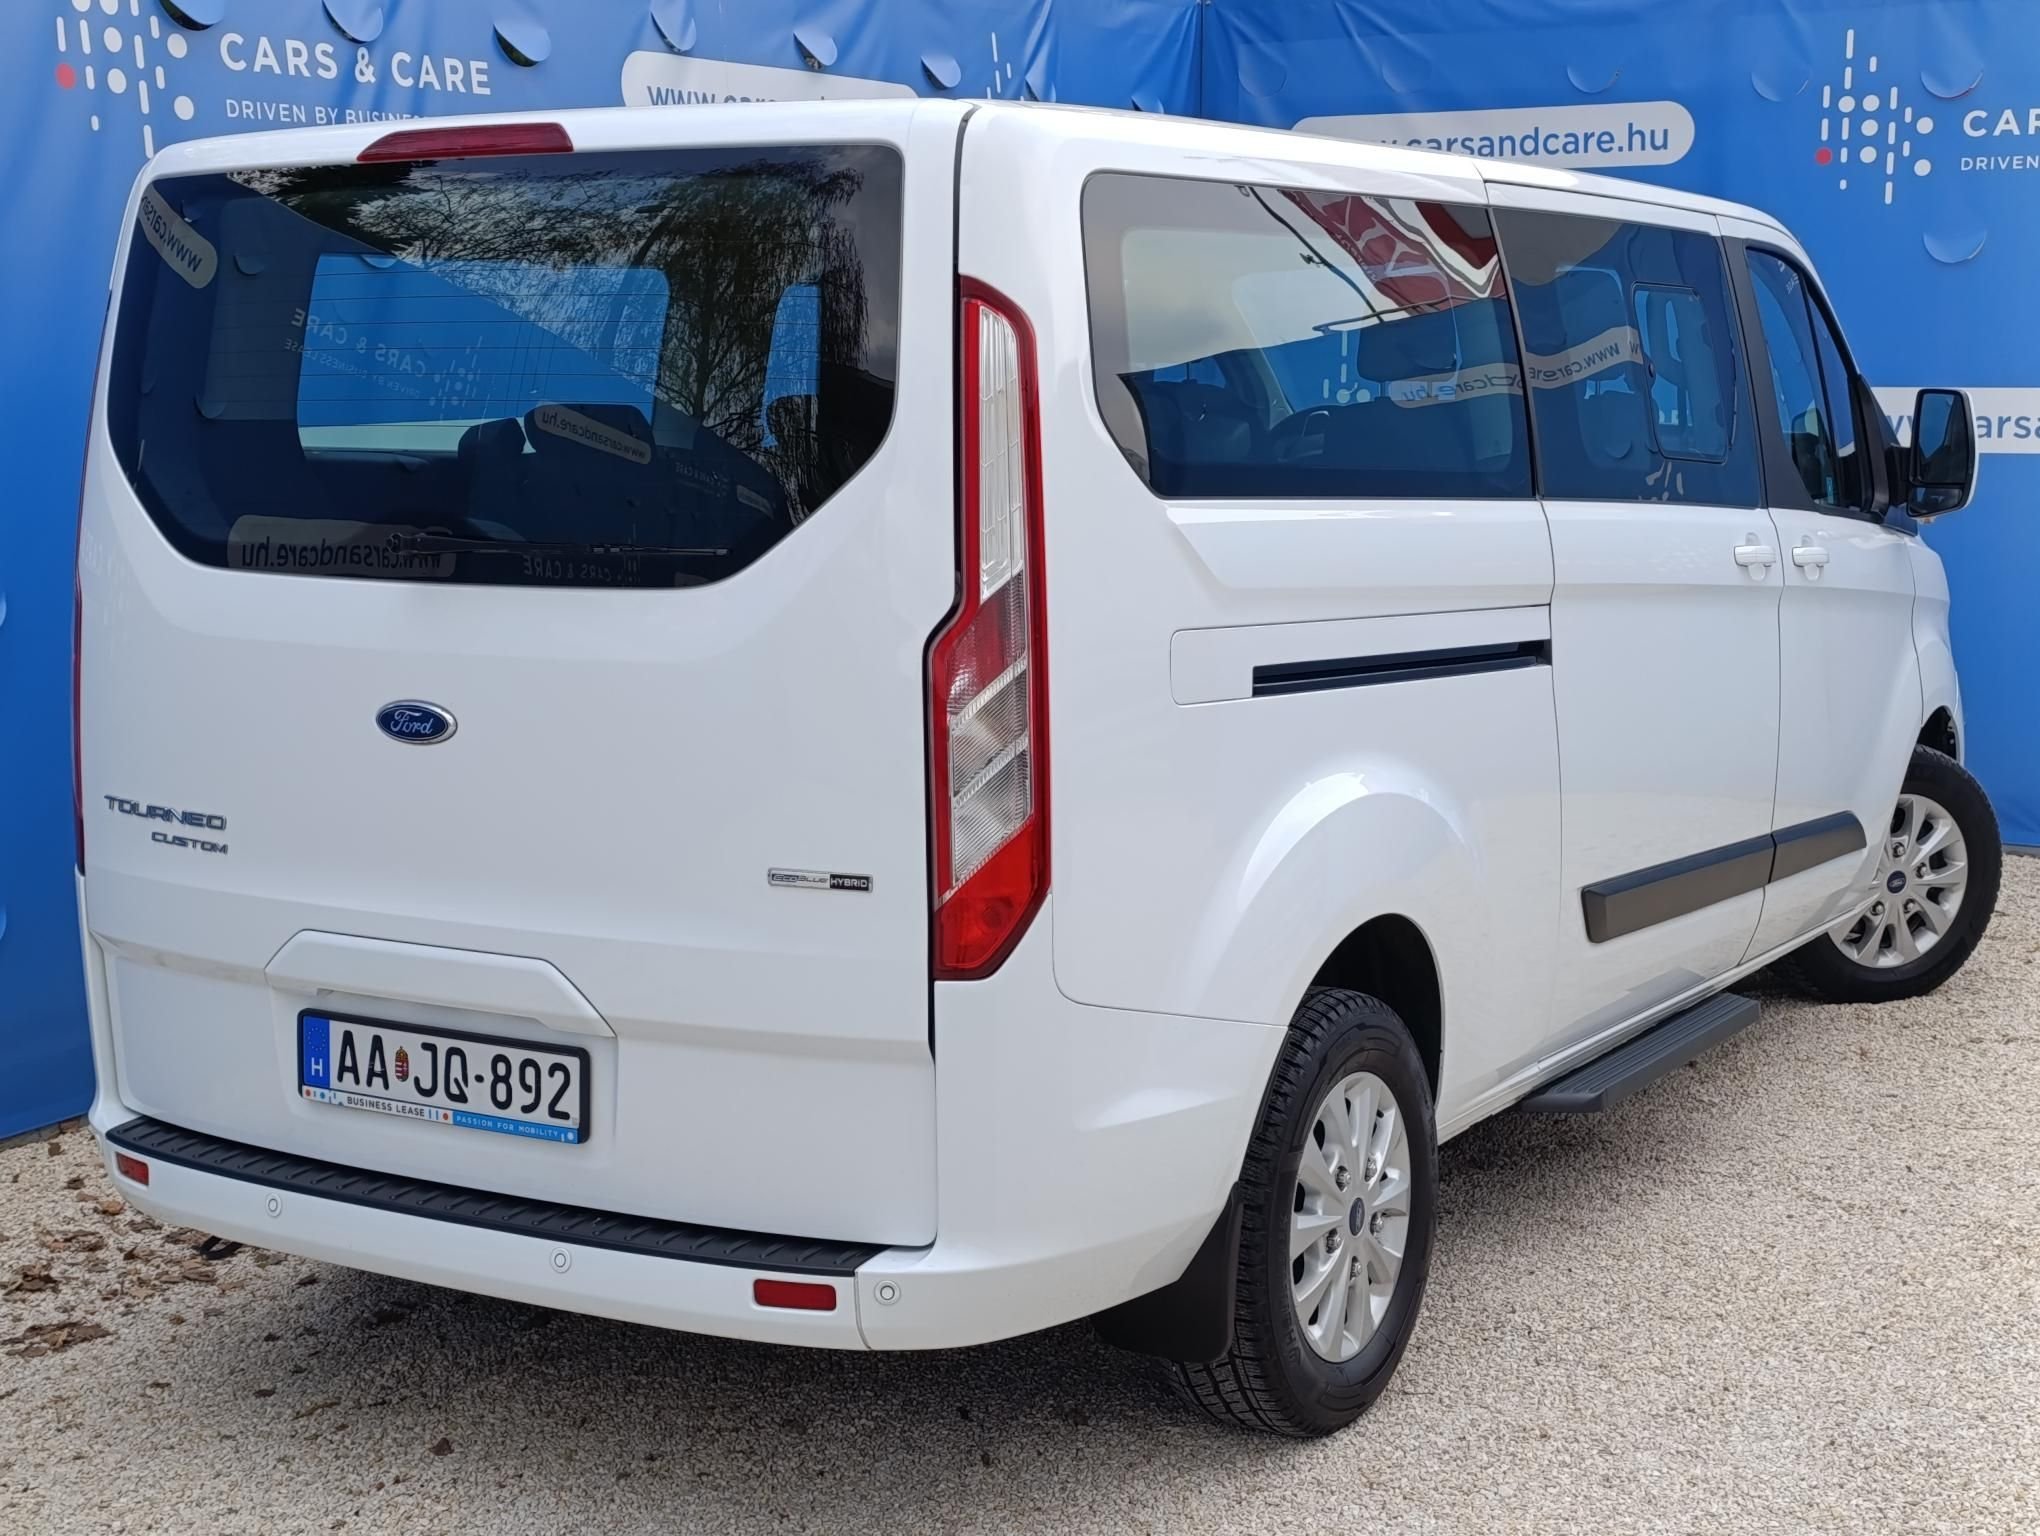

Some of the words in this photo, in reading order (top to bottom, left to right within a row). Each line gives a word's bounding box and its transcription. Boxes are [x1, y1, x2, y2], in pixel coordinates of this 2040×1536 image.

[219, 31, 338, 80] CARS
[354, 46, 376, 83] &
[391, 51, 491, 95] CARE
[226, 99, 306, 123] DRIVEN
[315, 106, 338, 125] BY
[345, 109, 420, 125] BUSIN
[1960, 156, 2040, 171] DRIVEN
[390, 709, 433, 735] Ford
[104, 795, 227, 830] TOURNEO
[151, 832, 228, 854] CUSTOM
[830, 877, 868, 888] HYBRID
[311, 1057, 323, 1077] H
[337, 1030, 390, 1090] AA
[413, 1042, 571, 1121] JQ-892
[346, 1096, 393, 1112] BUSINESS
[396, 1102, 425, 1118] LEASE
[456, 1115, 493, 1128] PASSION
[497, 1122, 515, 1131] FOR
[518, 1125, 559, 1138] MOBILITY
